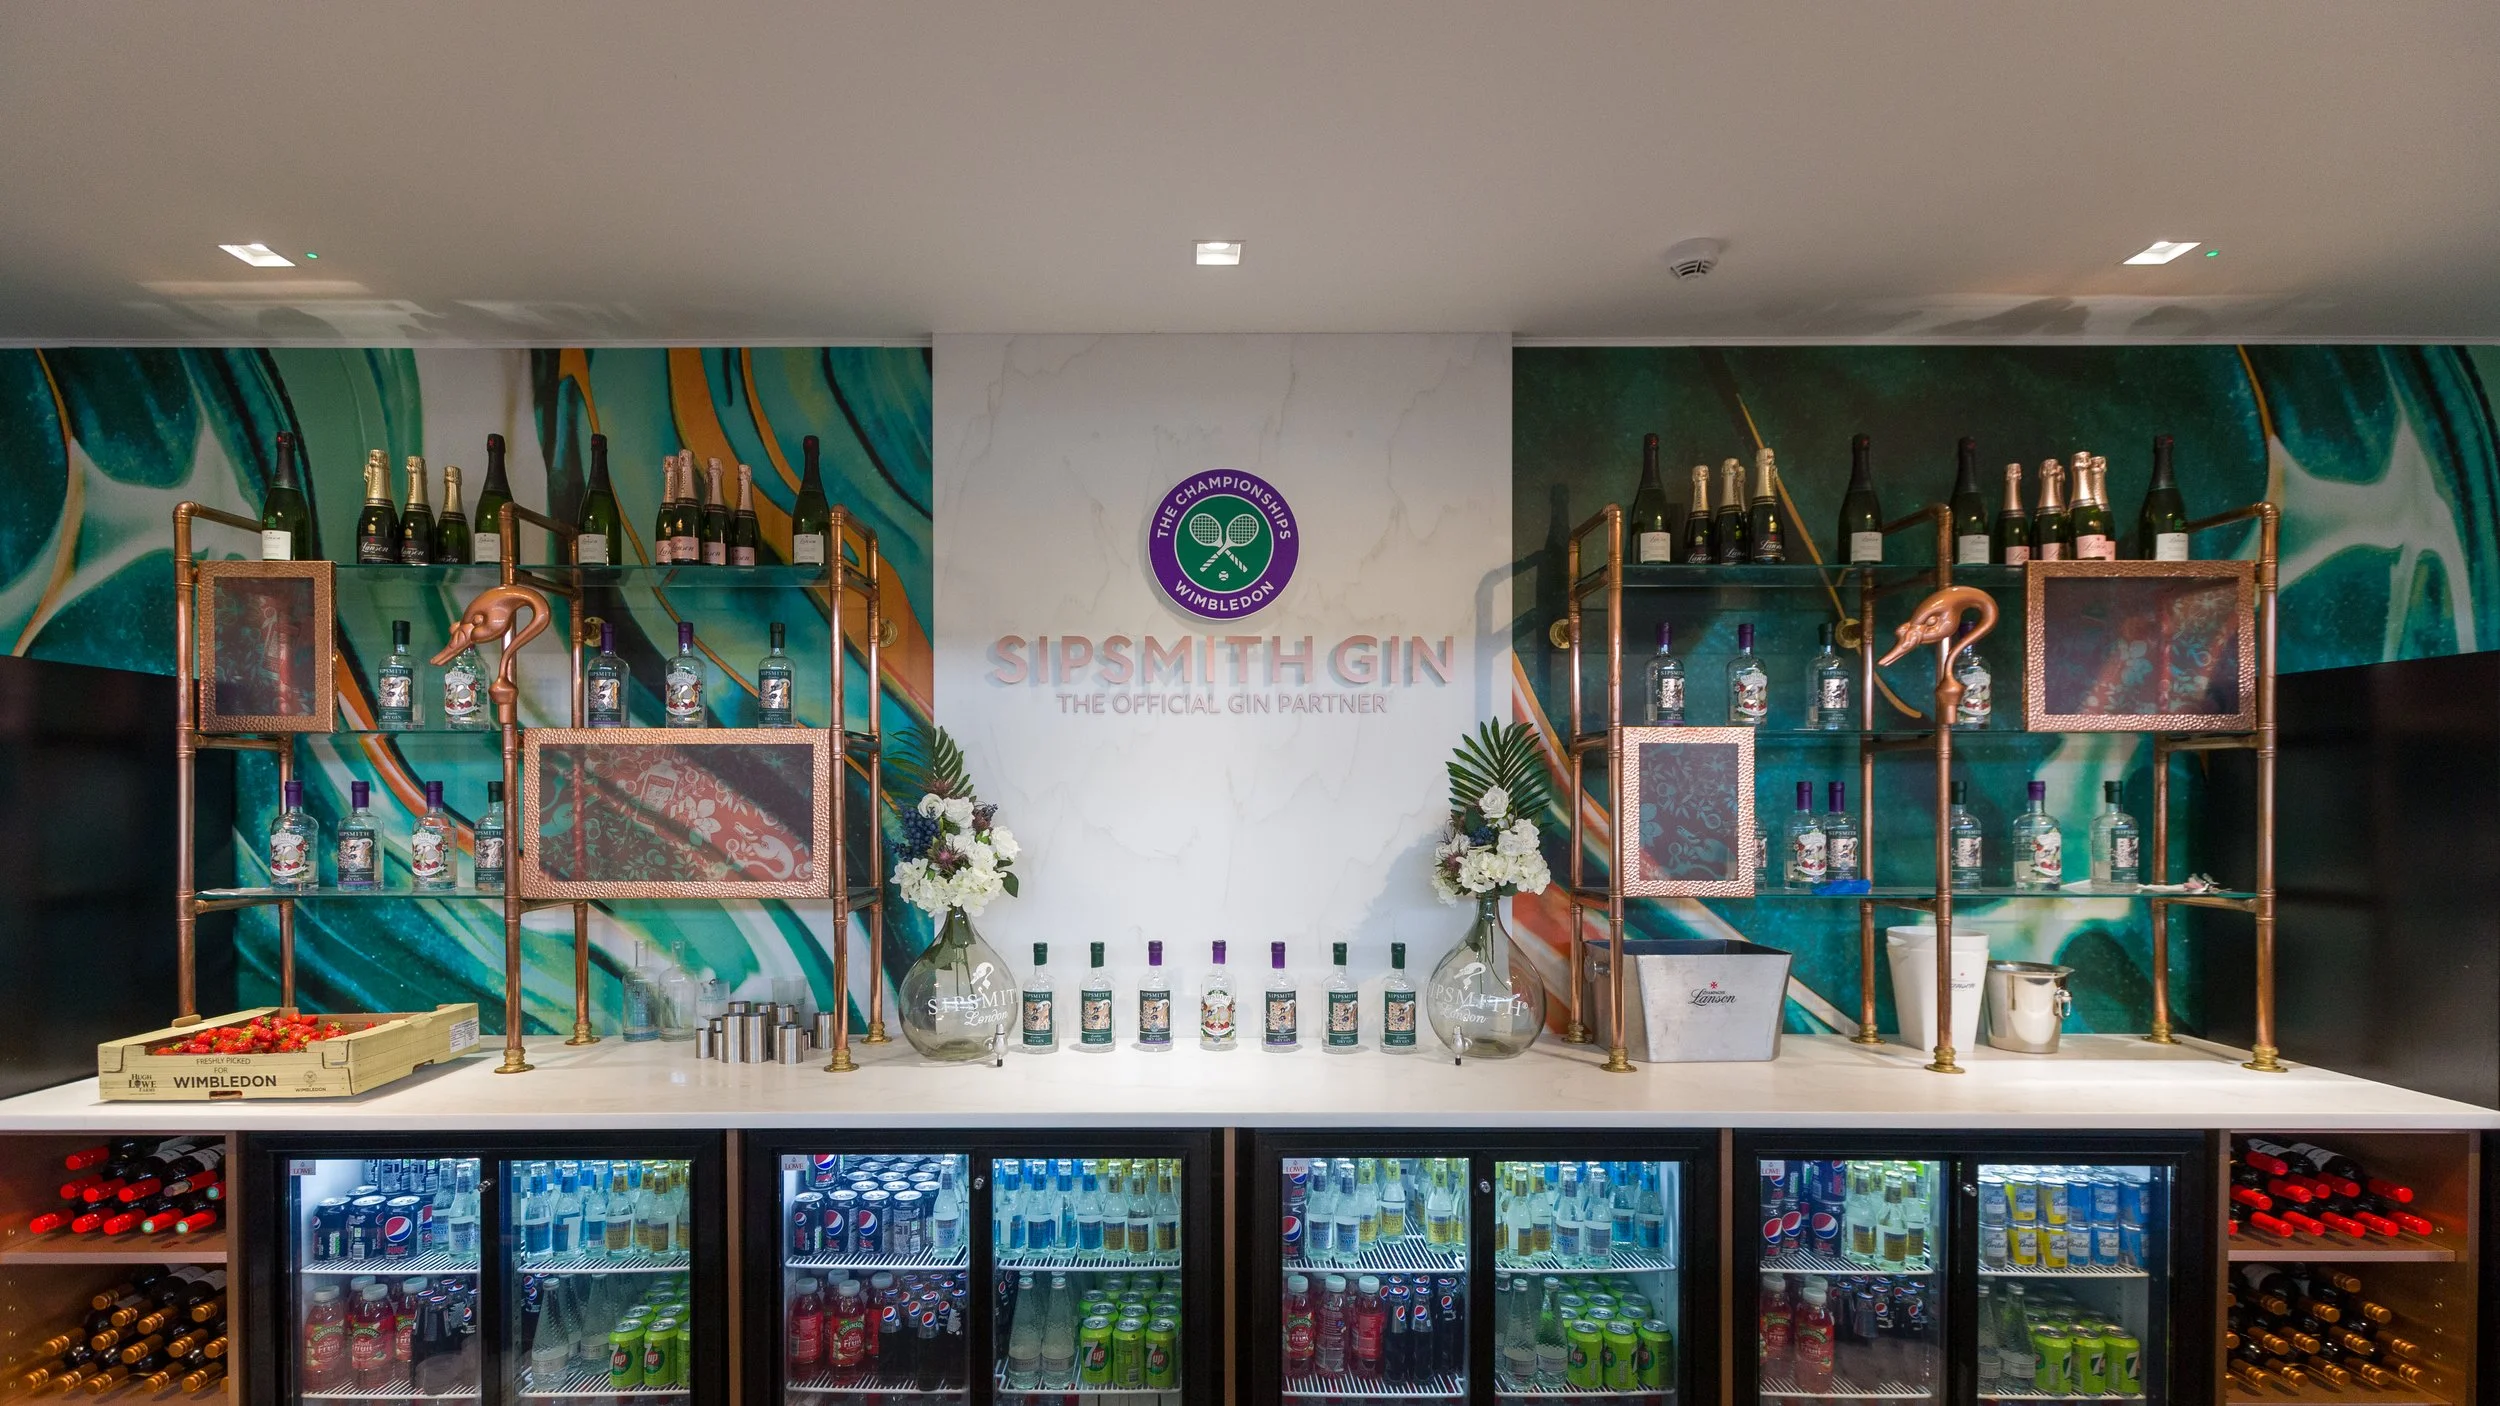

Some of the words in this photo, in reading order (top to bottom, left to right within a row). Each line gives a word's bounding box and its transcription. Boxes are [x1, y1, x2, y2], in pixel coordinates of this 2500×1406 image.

[1157, 505, 1178, 539] THE
[1175, 476, 1291, 540] CHAMPIONSHIPS
[361, 541, 389, 554] Lanson
[658, 546, 671, 557] Lan
[1175, 580, 1275, 611] WIMBLEDON
[995, 634, 1313, 684] SIPSMITH
[1336, 634, 1454, 684] GIN
[1056, 693, 1106, 714] THE
[1112, 693, 1220, 714] OFFICIAL
[1228, 693, 1271, 714] GIN
[1278, 693, 1387, 714] PARTNER
[927, 988, 1016, 1016] SIPSMIT
[1688, 988, 1737, 1006] Lanson
[964, 1007, 1009, 1026] London
[1440, 1001, 1488, 1024] London
[196, 1057, 225, 1065] FRESHLY
[226, 1057, 251, 1065] PICKED
[128, 1079, 157, 1089] LOWE
[173, 1075, 277, 1089] WIMBLEDON
